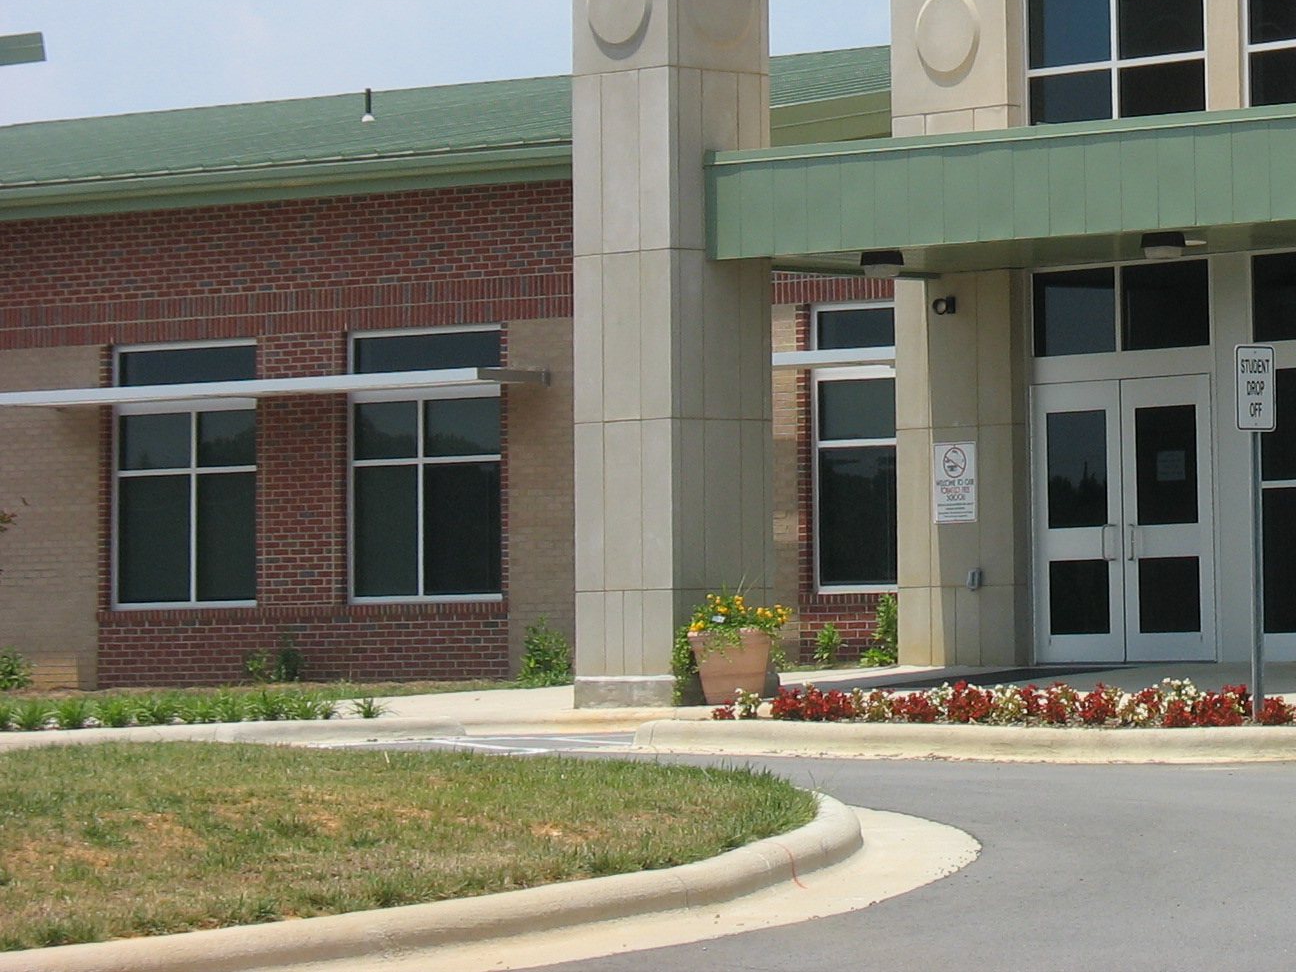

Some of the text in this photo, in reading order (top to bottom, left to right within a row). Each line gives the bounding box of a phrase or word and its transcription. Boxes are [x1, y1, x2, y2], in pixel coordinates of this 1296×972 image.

[1240, 358, 1270, 374] STUDENT
[1246, 380, 1265, 396] DROP
[1249, 402, 1263, 418] OFF
